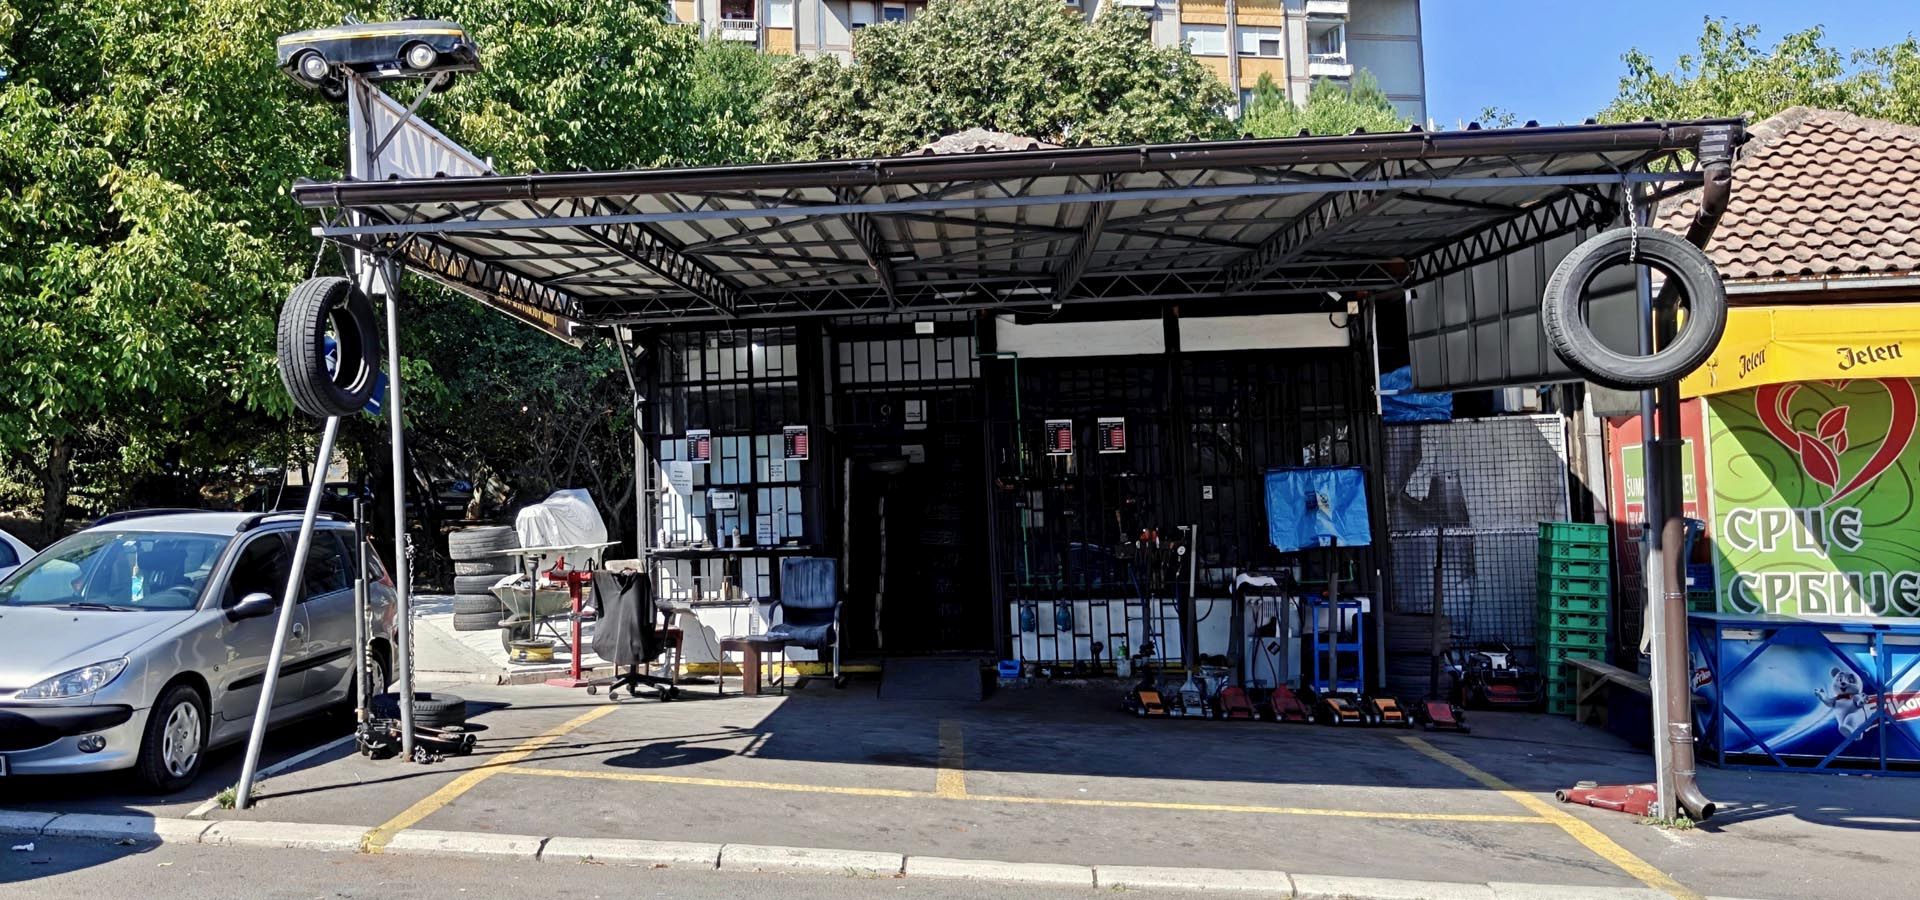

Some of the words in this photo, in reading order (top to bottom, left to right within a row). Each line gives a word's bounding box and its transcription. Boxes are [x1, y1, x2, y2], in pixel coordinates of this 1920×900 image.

[1738, 349, 1766, 379] Jelen
[1837, 343, 1904, 371] Jelen
[1725, 508, 1863, 559] СРЦЕ
[1728, 572, 1920, 616] СРБИЈЕ
